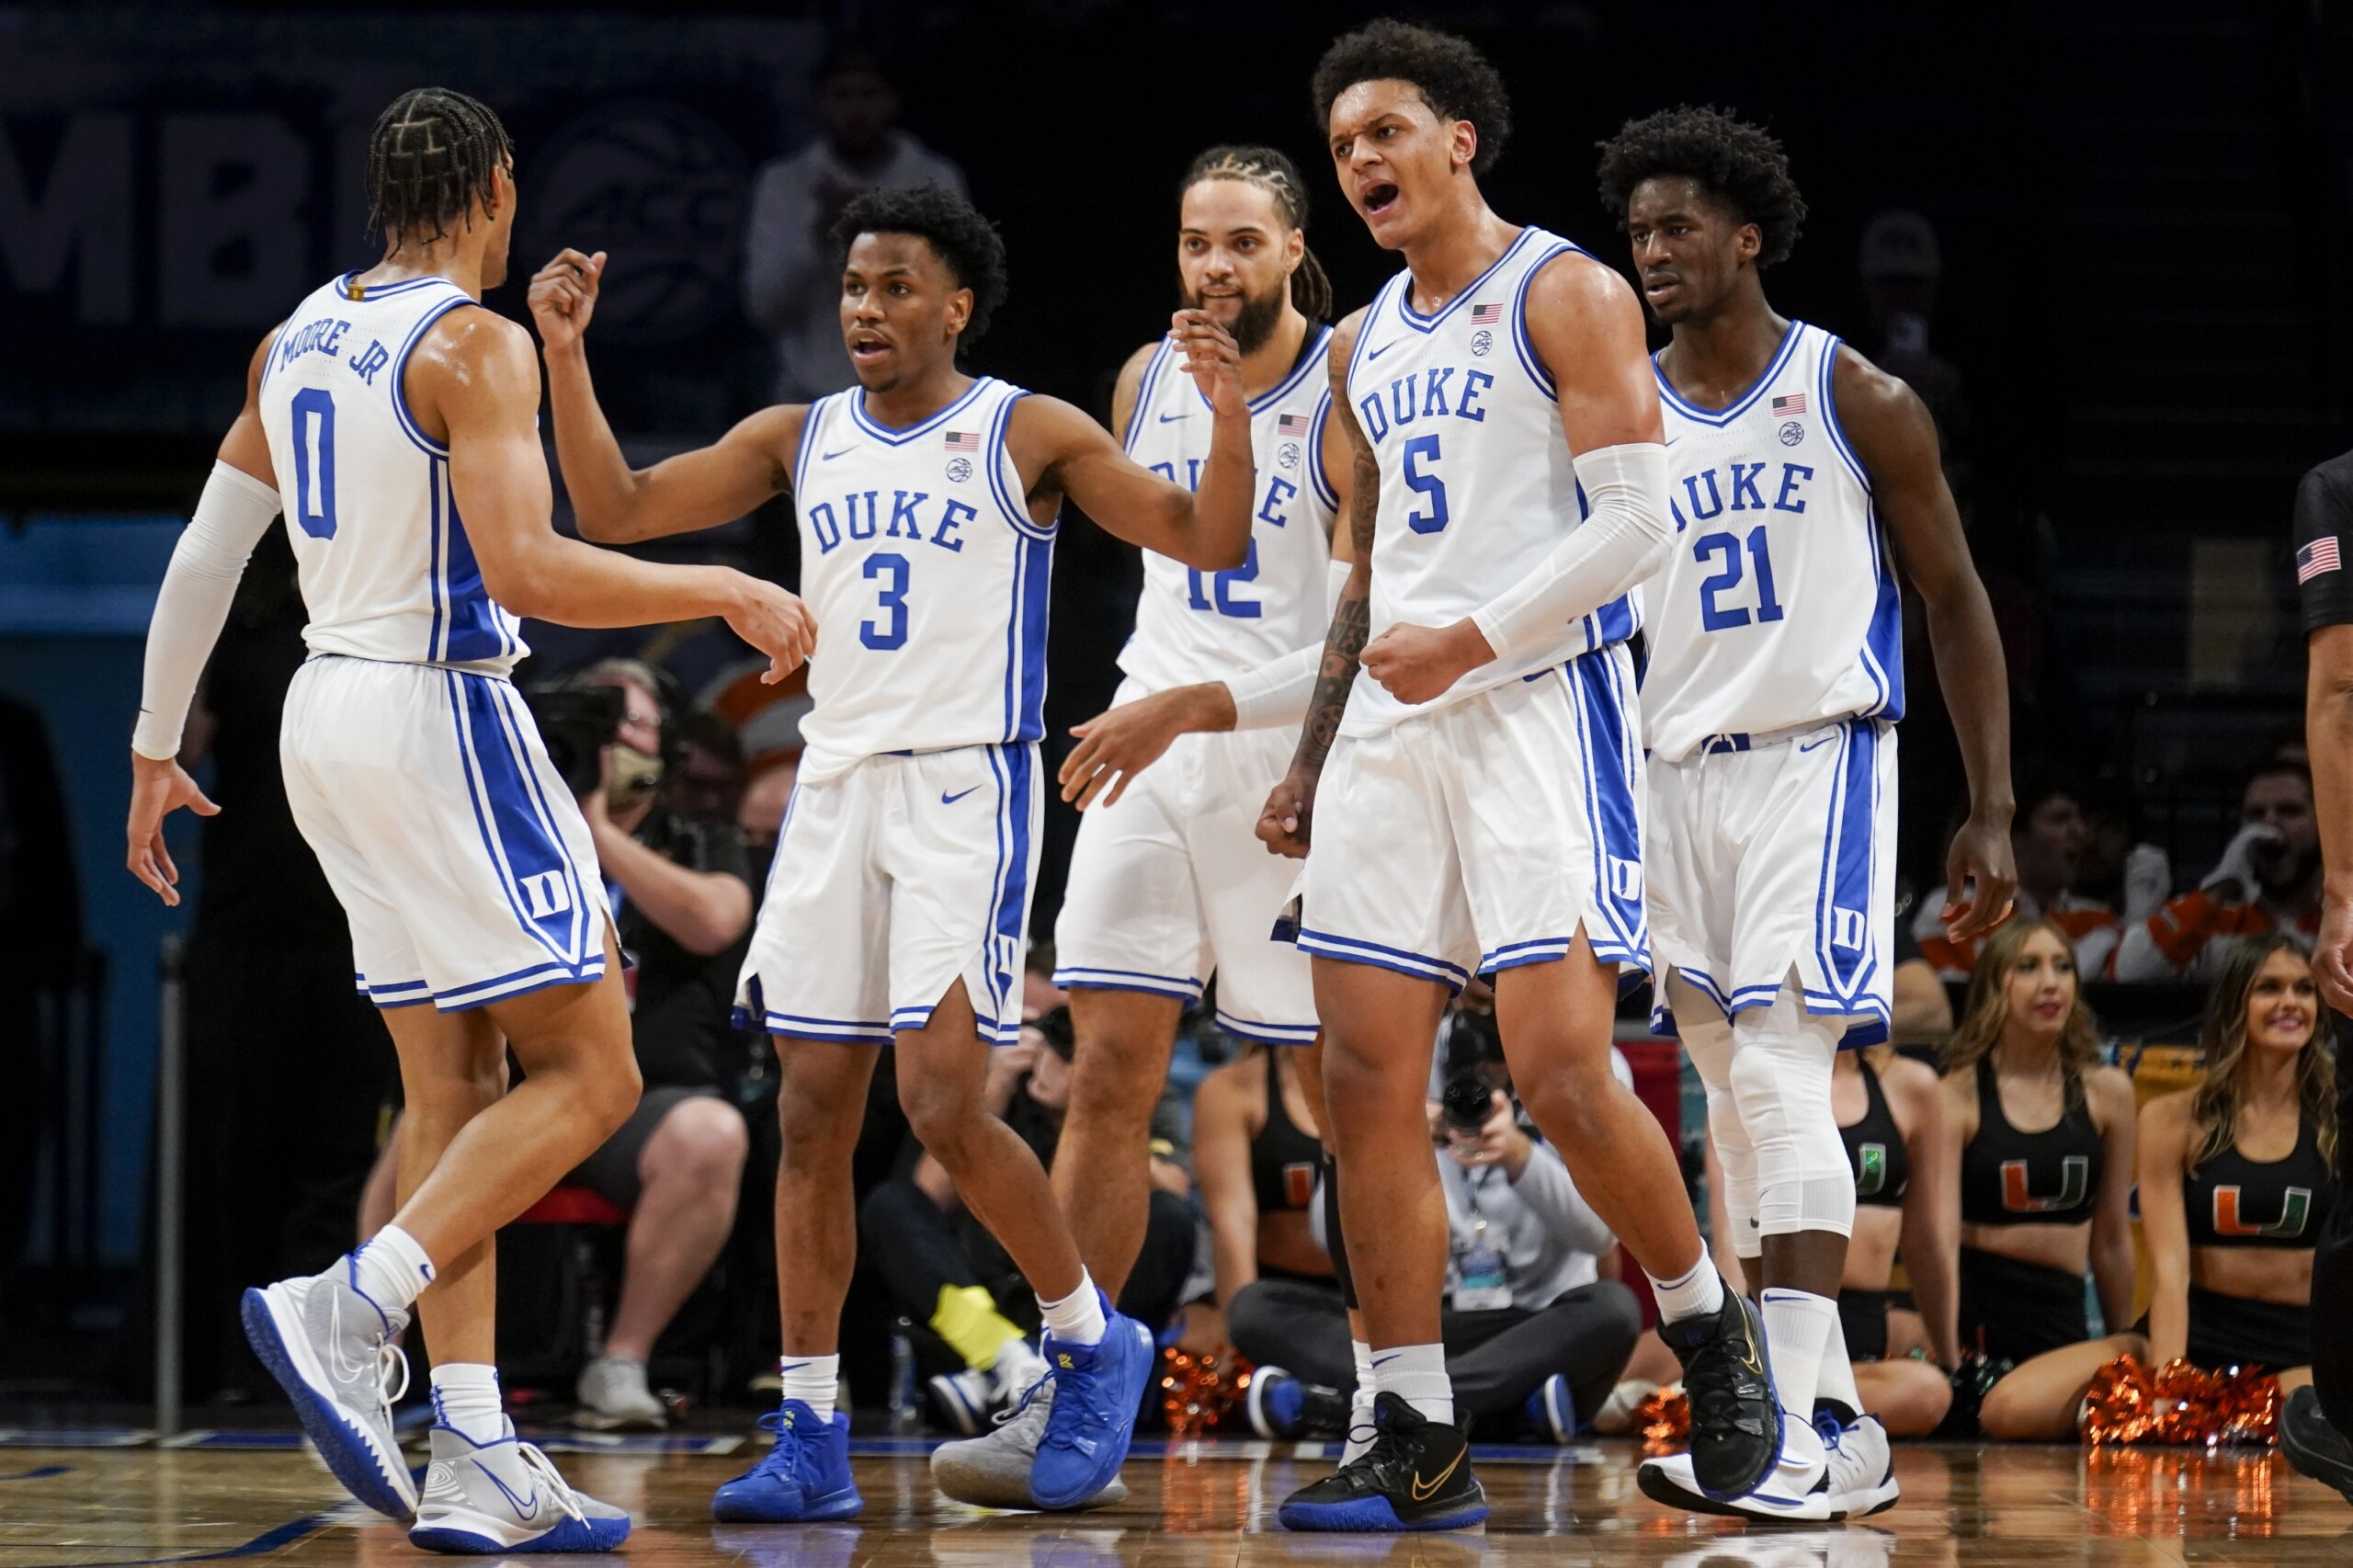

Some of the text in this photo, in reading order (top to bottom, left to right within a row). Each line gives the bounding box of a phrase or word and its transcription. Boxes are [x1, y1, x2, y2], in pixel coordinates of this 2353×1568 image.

[0, 113, 371, 329] MB
[279, 317, 390, 386] MOORE JR
[1360, 368, 1495, 445] DUKE
[290, 387, 337, 540] 0
[1403, 434, 1449, 535] 5
[809, 490, 979, 555] DUKE
[859, 552, 910, 651] 3
[1693, 525, 1784, 632] 21
[519, 869, 571, 919] D
[1608, 854, 1642, 901] D
[1832, 905, 1866, 951] D
[1999, 1155, 2089, 1212] U
[2213, 1185, 2313, 1238] U
